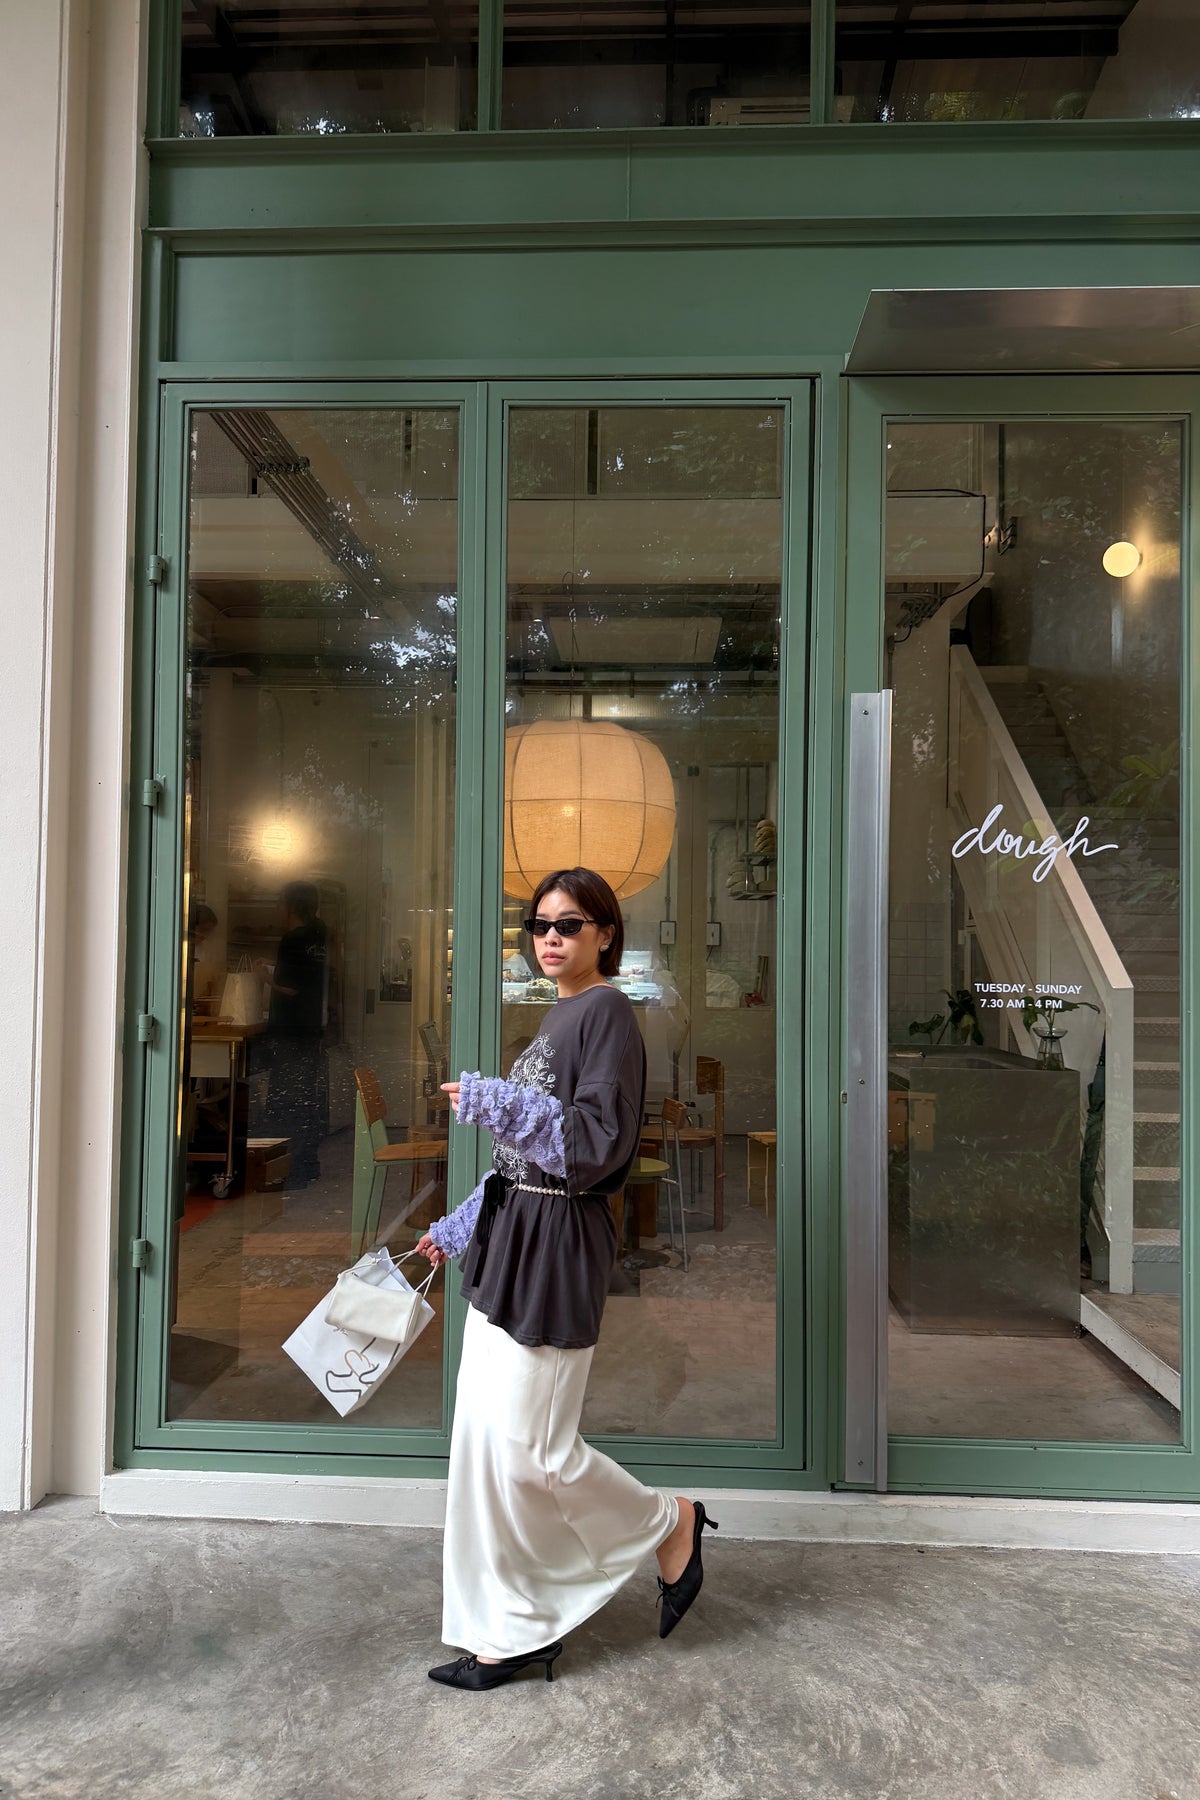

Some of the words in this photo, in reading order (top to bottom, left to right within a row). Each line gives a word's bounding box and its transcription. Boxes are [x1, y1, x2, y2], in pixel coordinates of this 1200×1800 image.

[952, 803, 1119, 882] dough
[974, 983, 1025, 993] TUESDAY
[1035, 984, 1082, 994] SUNDAY
[980, 999, 1004, 1008] 7.30
[1006, 999, 1025, 1008] AM
[1035, 1000, 1042, 1008] 4
[1045, 1000, 1063, 1008] PM
